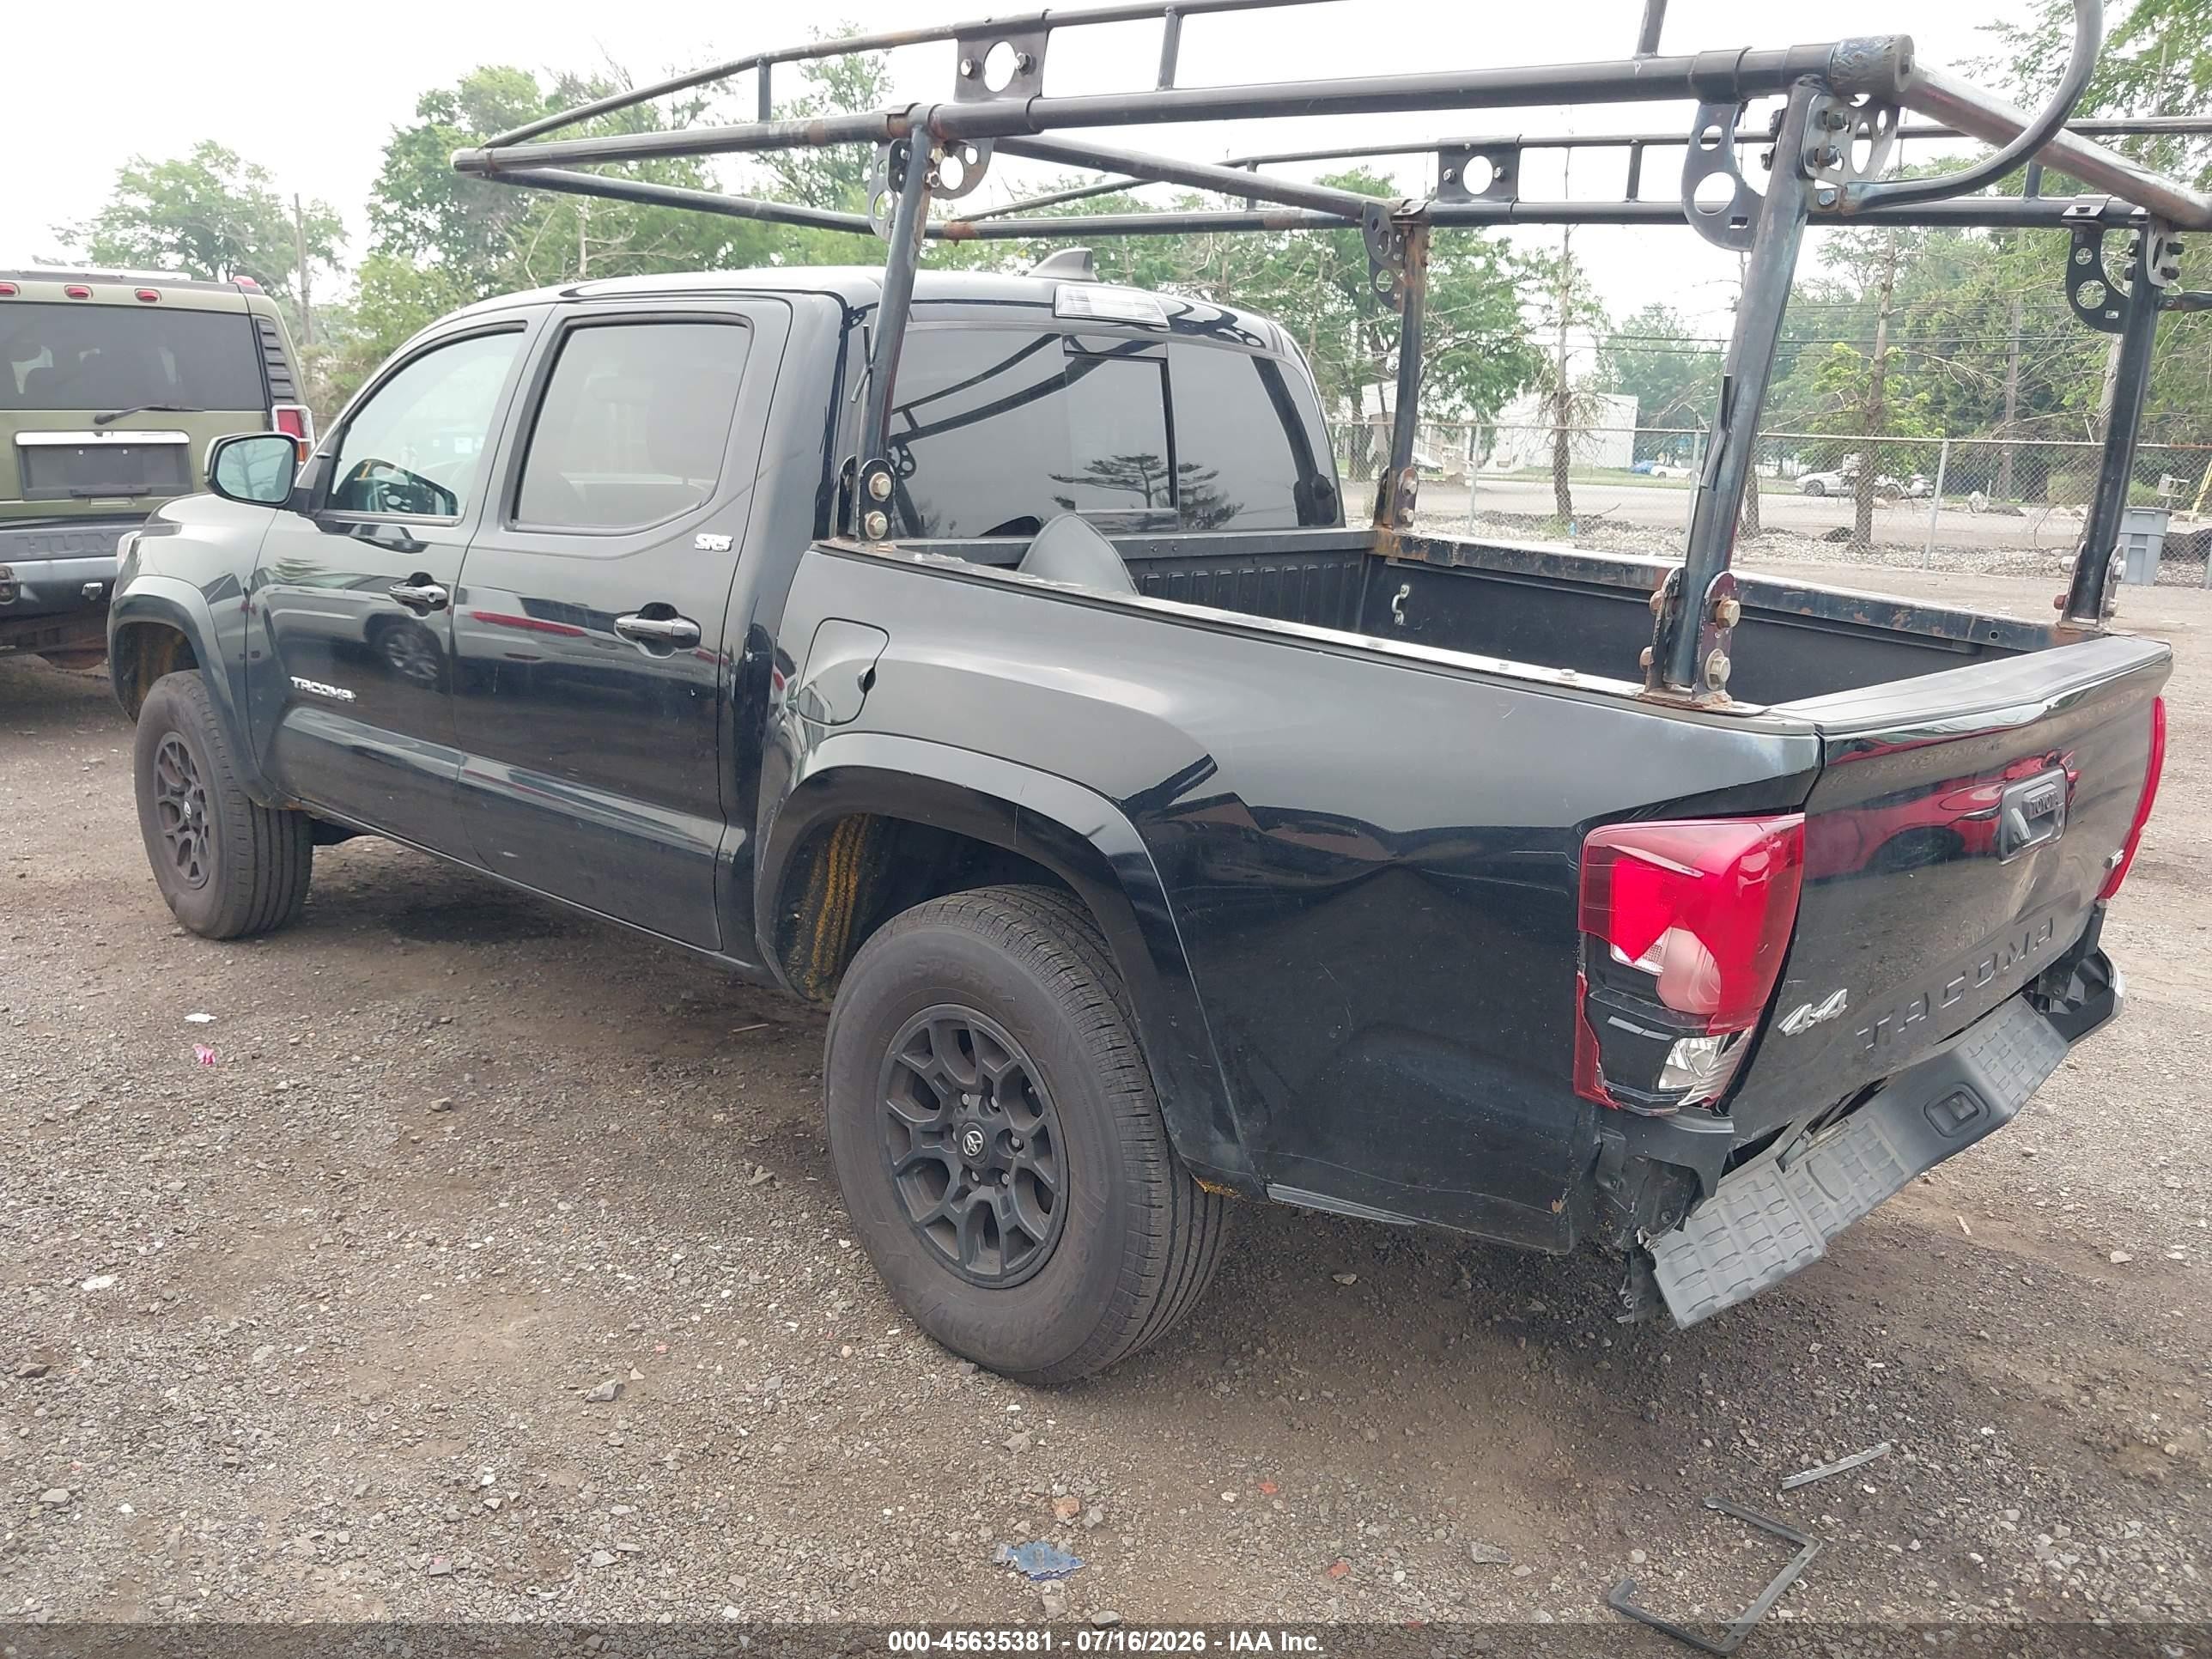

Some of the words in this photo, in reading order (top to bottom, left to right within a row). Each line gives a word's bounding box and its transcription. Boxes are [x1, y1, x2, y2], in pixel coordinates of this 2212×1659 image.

[694, 533, 733, 551] SR5
[289, 675, 357, 702] TACOMA
[1856, 917, 2054, 1050] TACOMA
[1777, 988, 1848, 1036] 4x4
